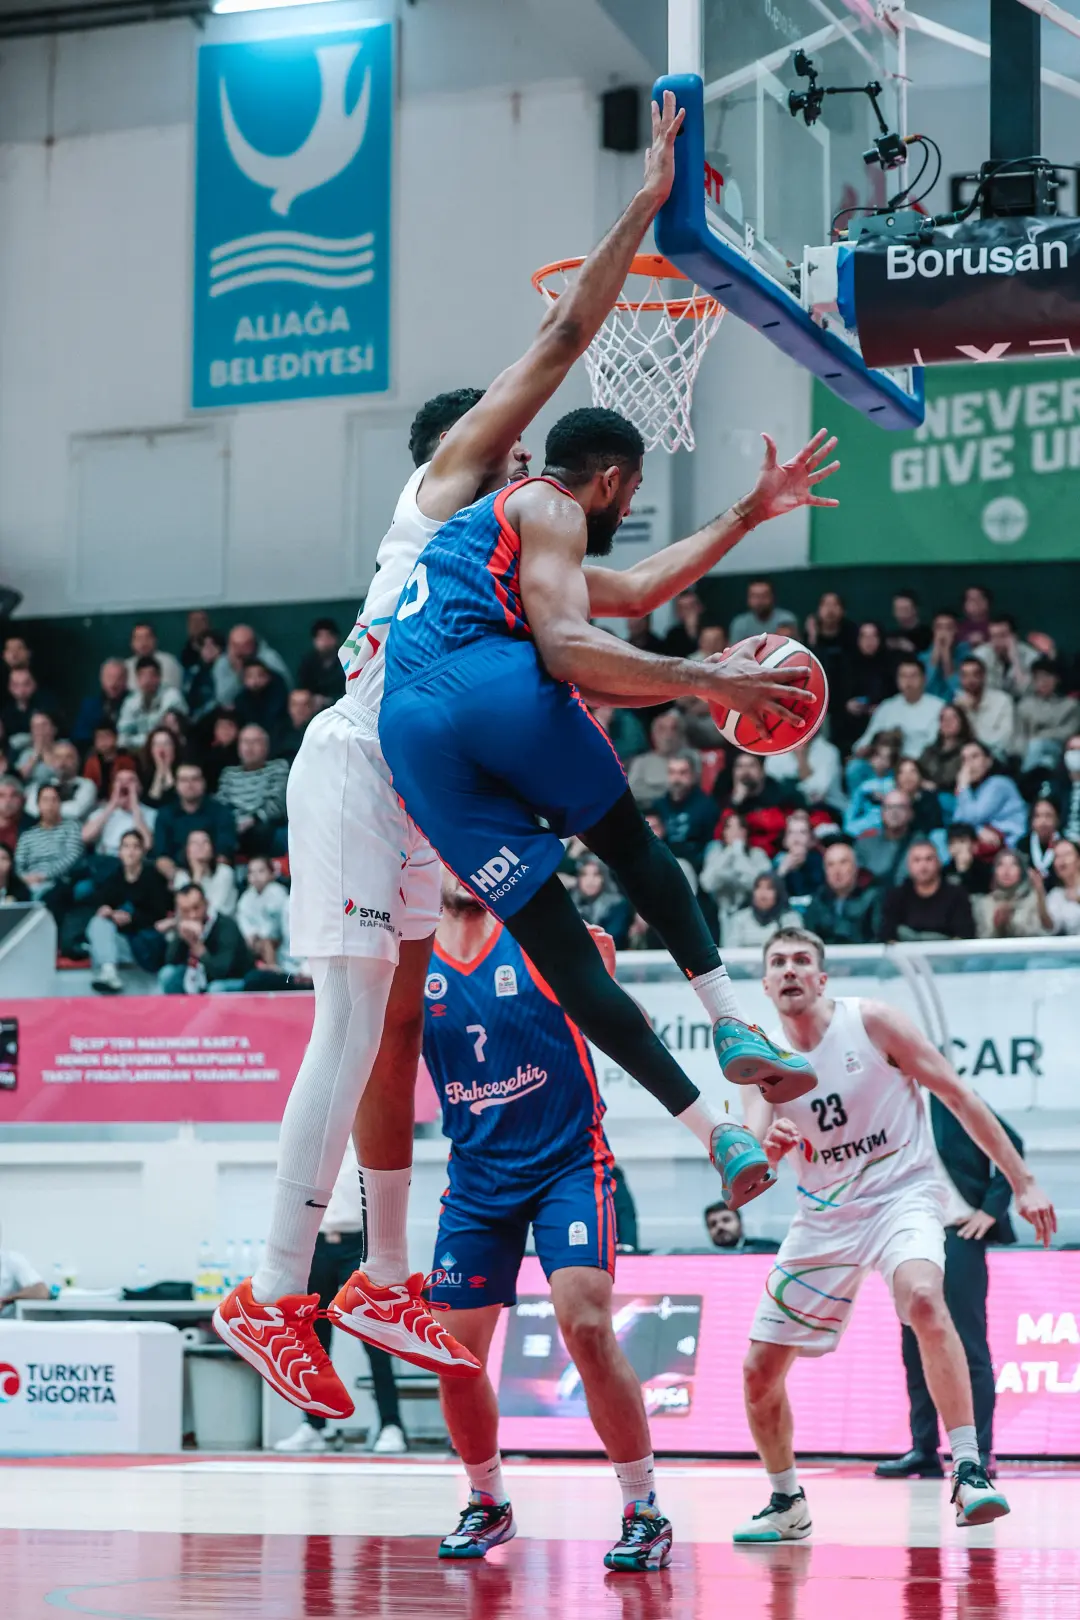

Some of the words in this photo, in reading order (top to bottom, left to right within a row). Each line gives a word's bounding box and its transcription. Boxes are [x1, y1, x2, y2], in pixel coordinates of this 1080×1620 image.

[886, 239, 1069, 281] Borusan
[891, 434, 1015, 492] GIVE
[470, 845, 520, 893] HDI
[359, 907, 391, 923] STAR
[466, 1024, 488, 1062] 7
[445, 1063, 547, 1107] Bahçeşehir
[810, 1092, 848, 1132] 23
[994, 1361, 1080, 1393] ATL
